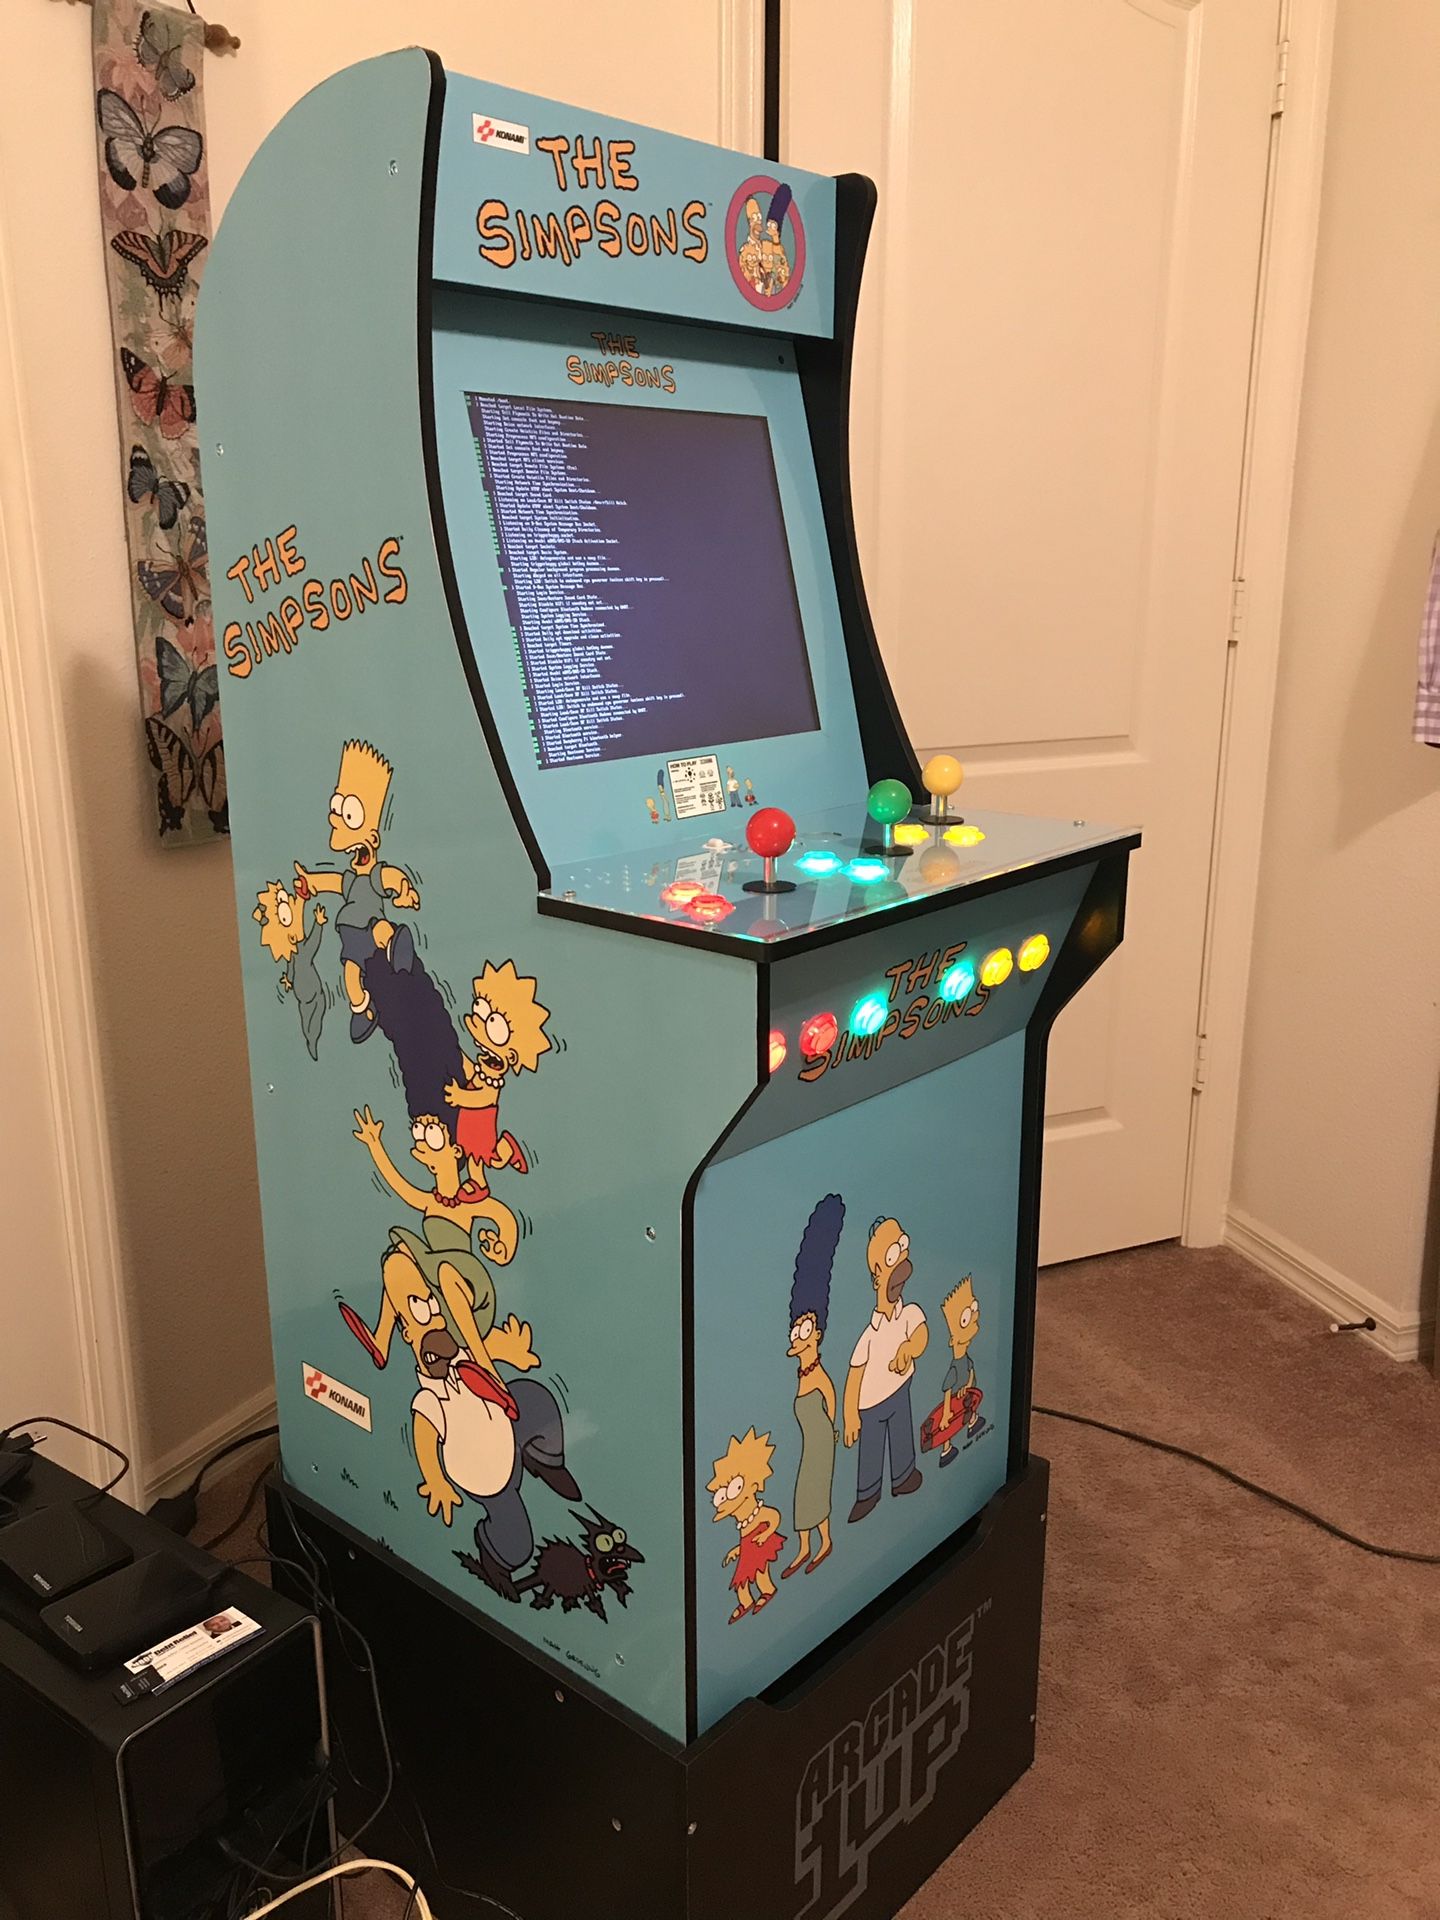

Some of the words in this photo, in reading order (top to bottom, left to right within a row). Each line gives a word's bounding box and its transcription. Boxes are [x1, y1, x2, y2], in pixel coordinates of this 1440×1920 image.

[495, 129, 525, 144] KONAMI
[536, 134, 639, 191] THE
[476, 199, 709, 269] SIMPSONS
[590, 331, 640, 359] THE
[566, 355, 677, 394] SIMPSONS
[226, 524, 307, 604] THE
[223, 537, 408, 679] SIMPSONS
[328, 1389, 366, 1418] KONAMI
[796, 1613, 975, 1835] ARCADE
